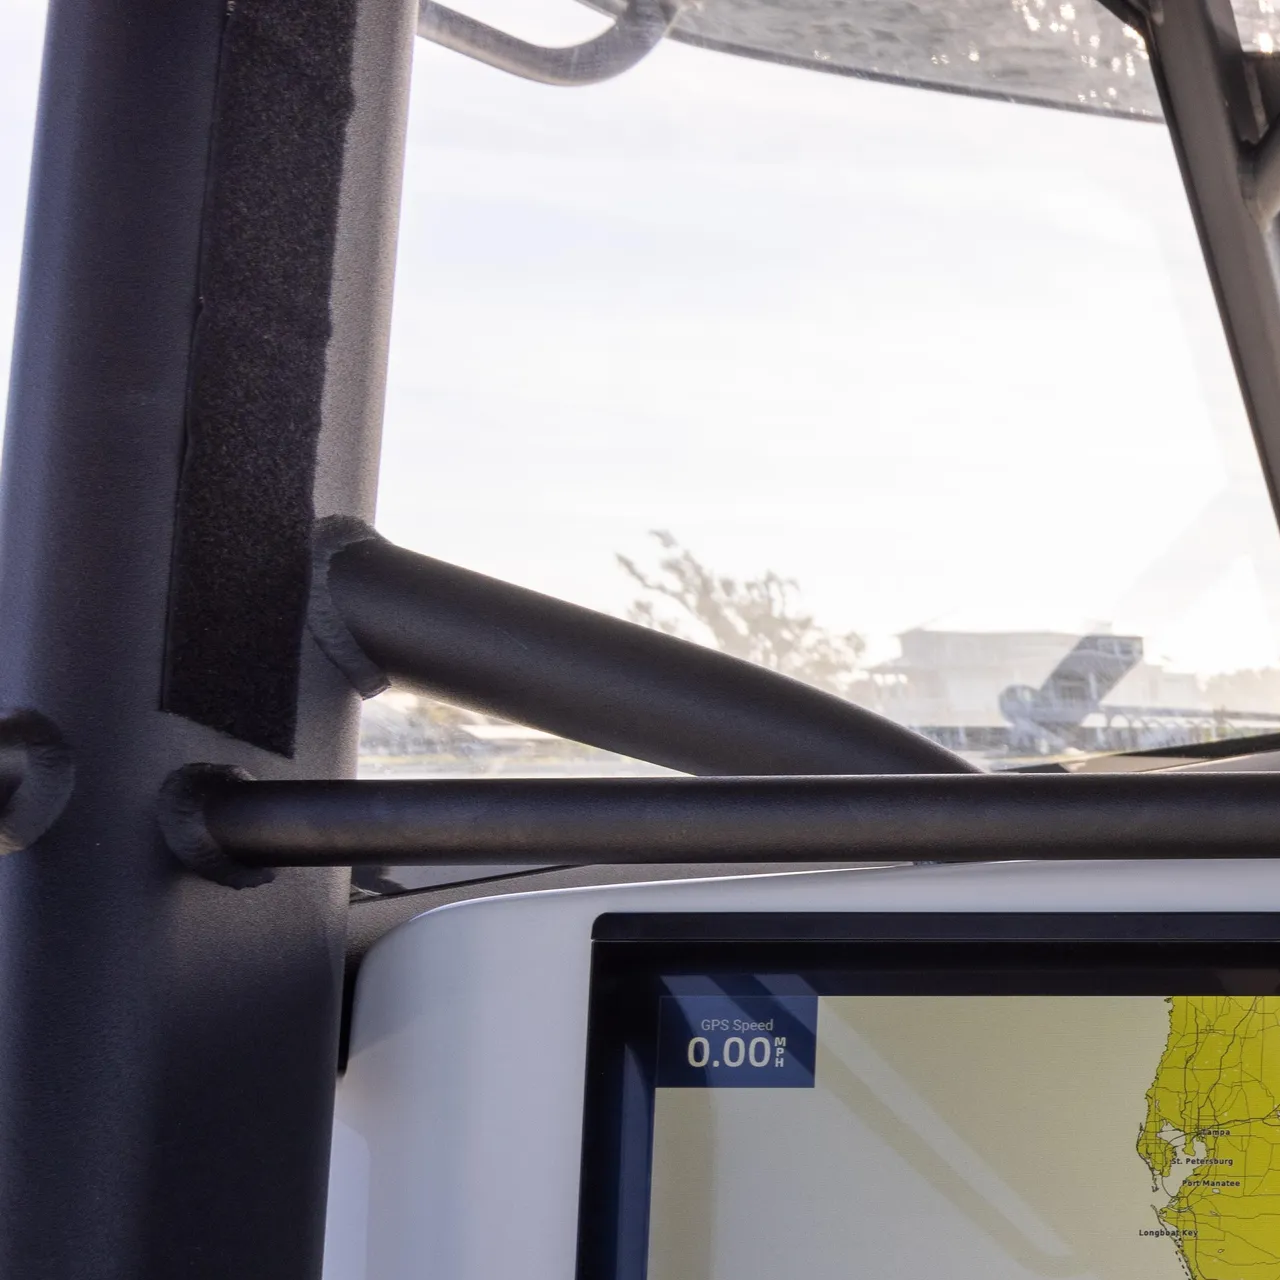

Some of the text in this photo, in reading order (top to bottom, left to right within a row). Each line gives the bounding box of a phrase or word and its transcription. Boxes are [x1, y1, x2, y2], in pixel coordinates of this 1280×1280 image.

[701, 1018, 774, 1035] GPS Speed
[687, 1036, 771, 1068] 0.00
[1201, 1129, 1231, 1137] Tampa
[1186, 1158, 1233, 1167] Petersburg
[1139, 1229, 1198, 1239] Longboat Key
